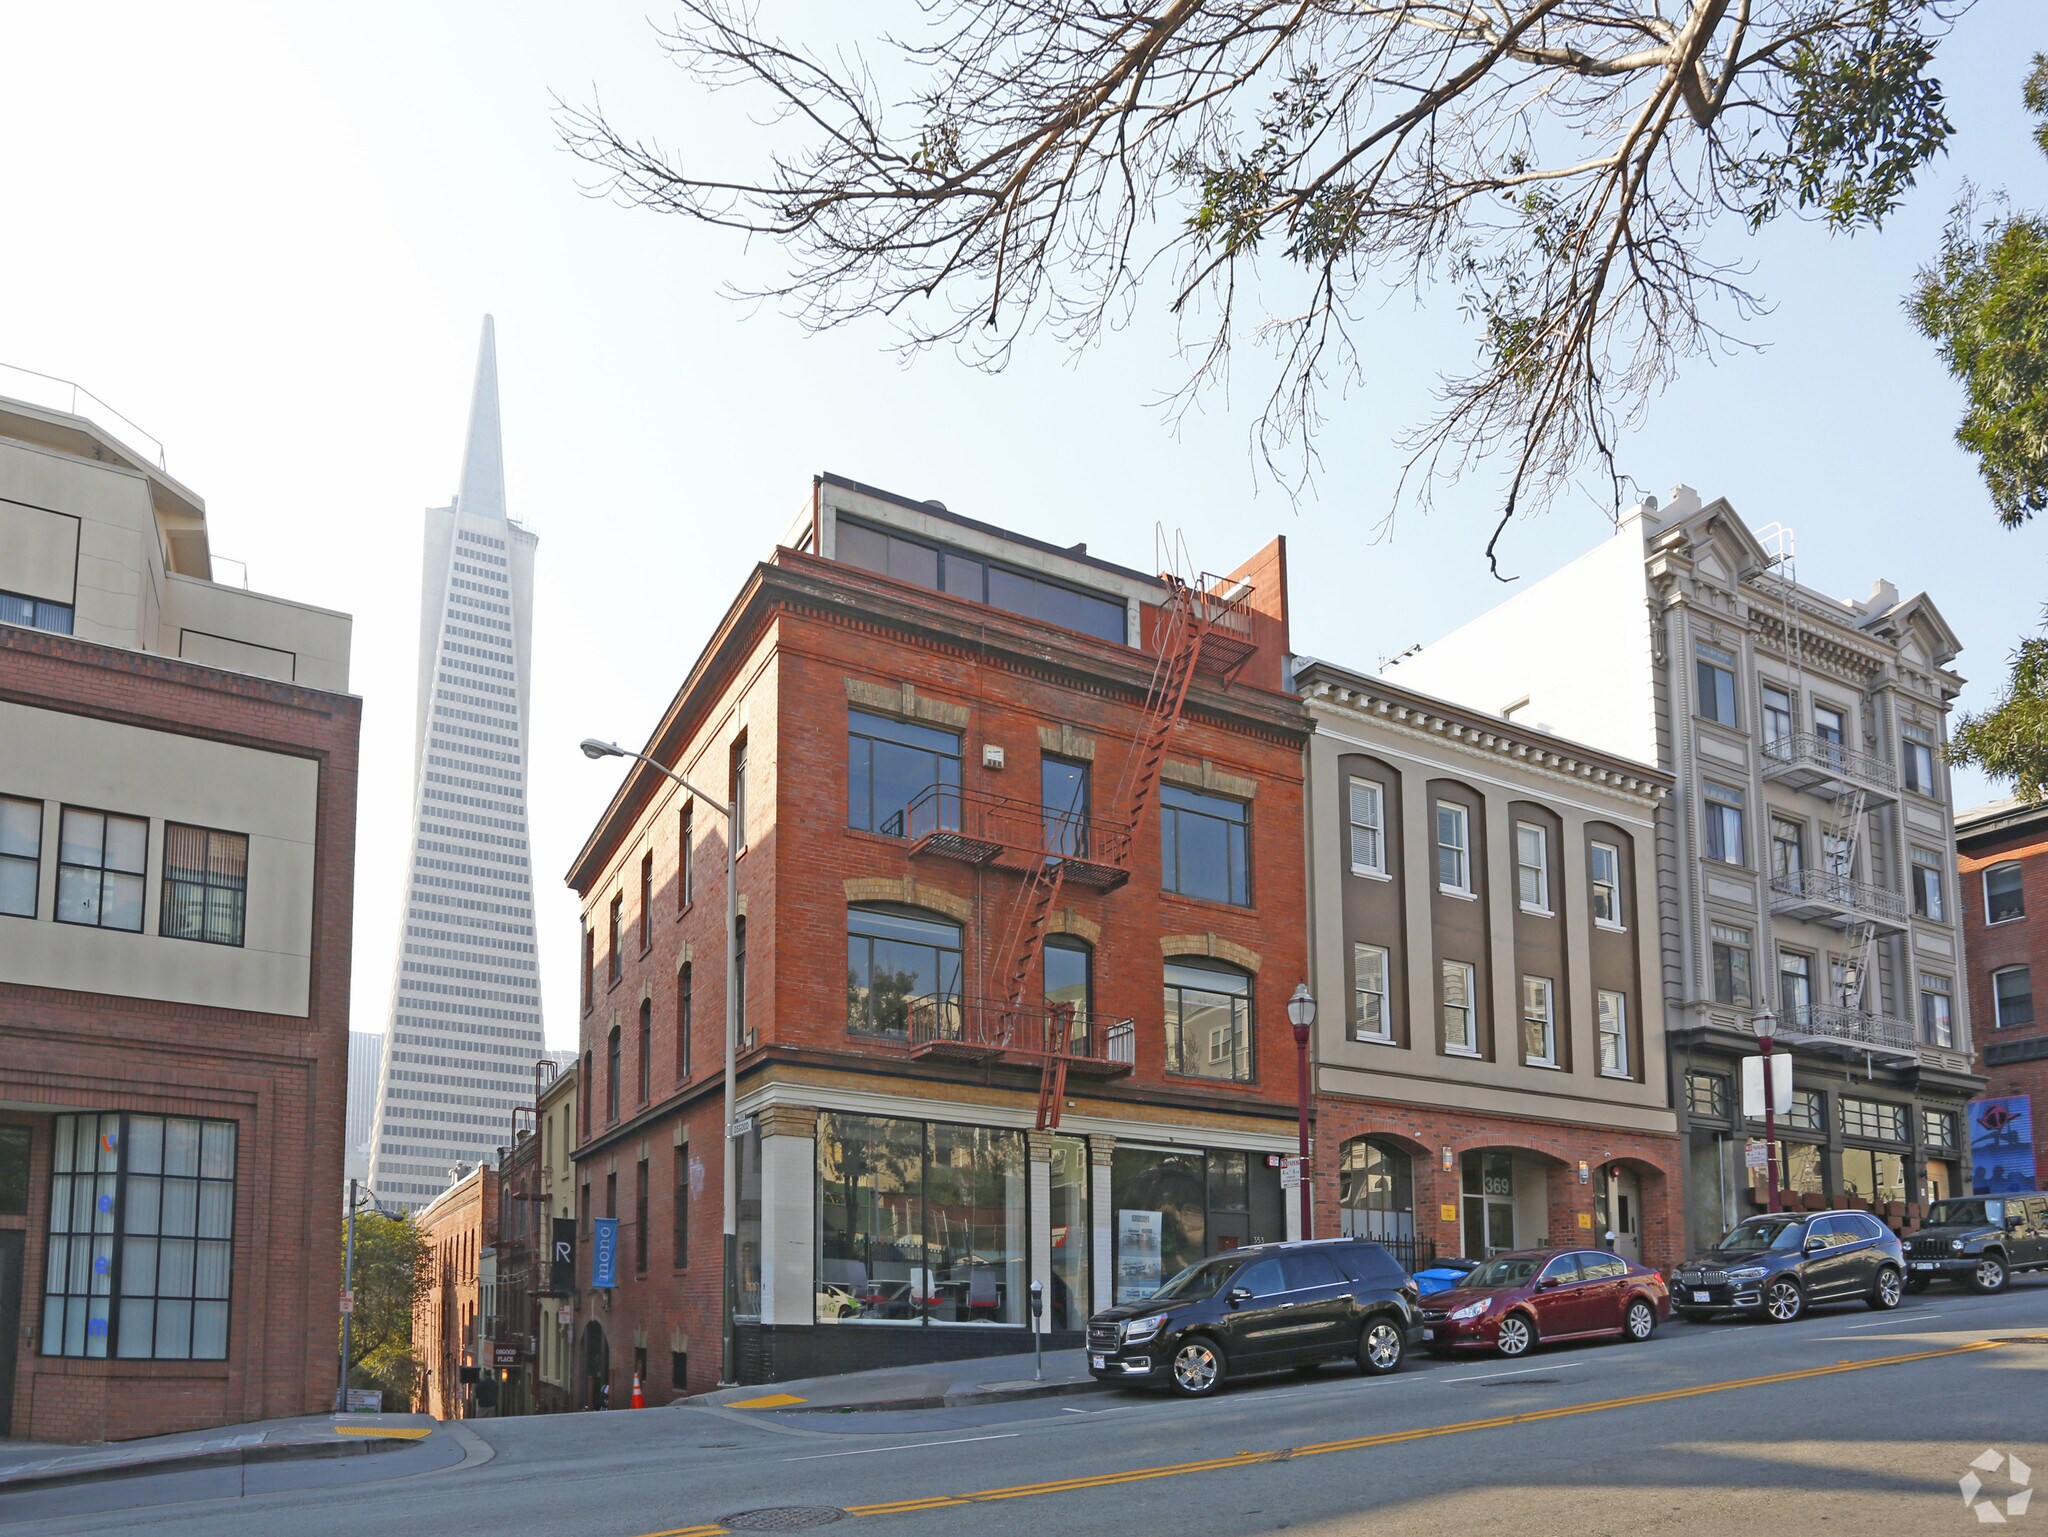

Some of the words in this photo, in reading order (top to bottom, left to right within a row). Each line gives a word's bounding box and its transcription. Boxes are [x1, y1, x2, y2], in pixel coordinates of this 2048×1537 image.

[734, 1121, 749, 1134] OSGOOD
[1485, 1176, 1510, 1195] 369
[88, 1134, 116, 1337] veem
[1253, 1236, 1265, 1244] 353
[556, 1241, 571, 1263] R
[599, 1227, 611, 1281] mono
